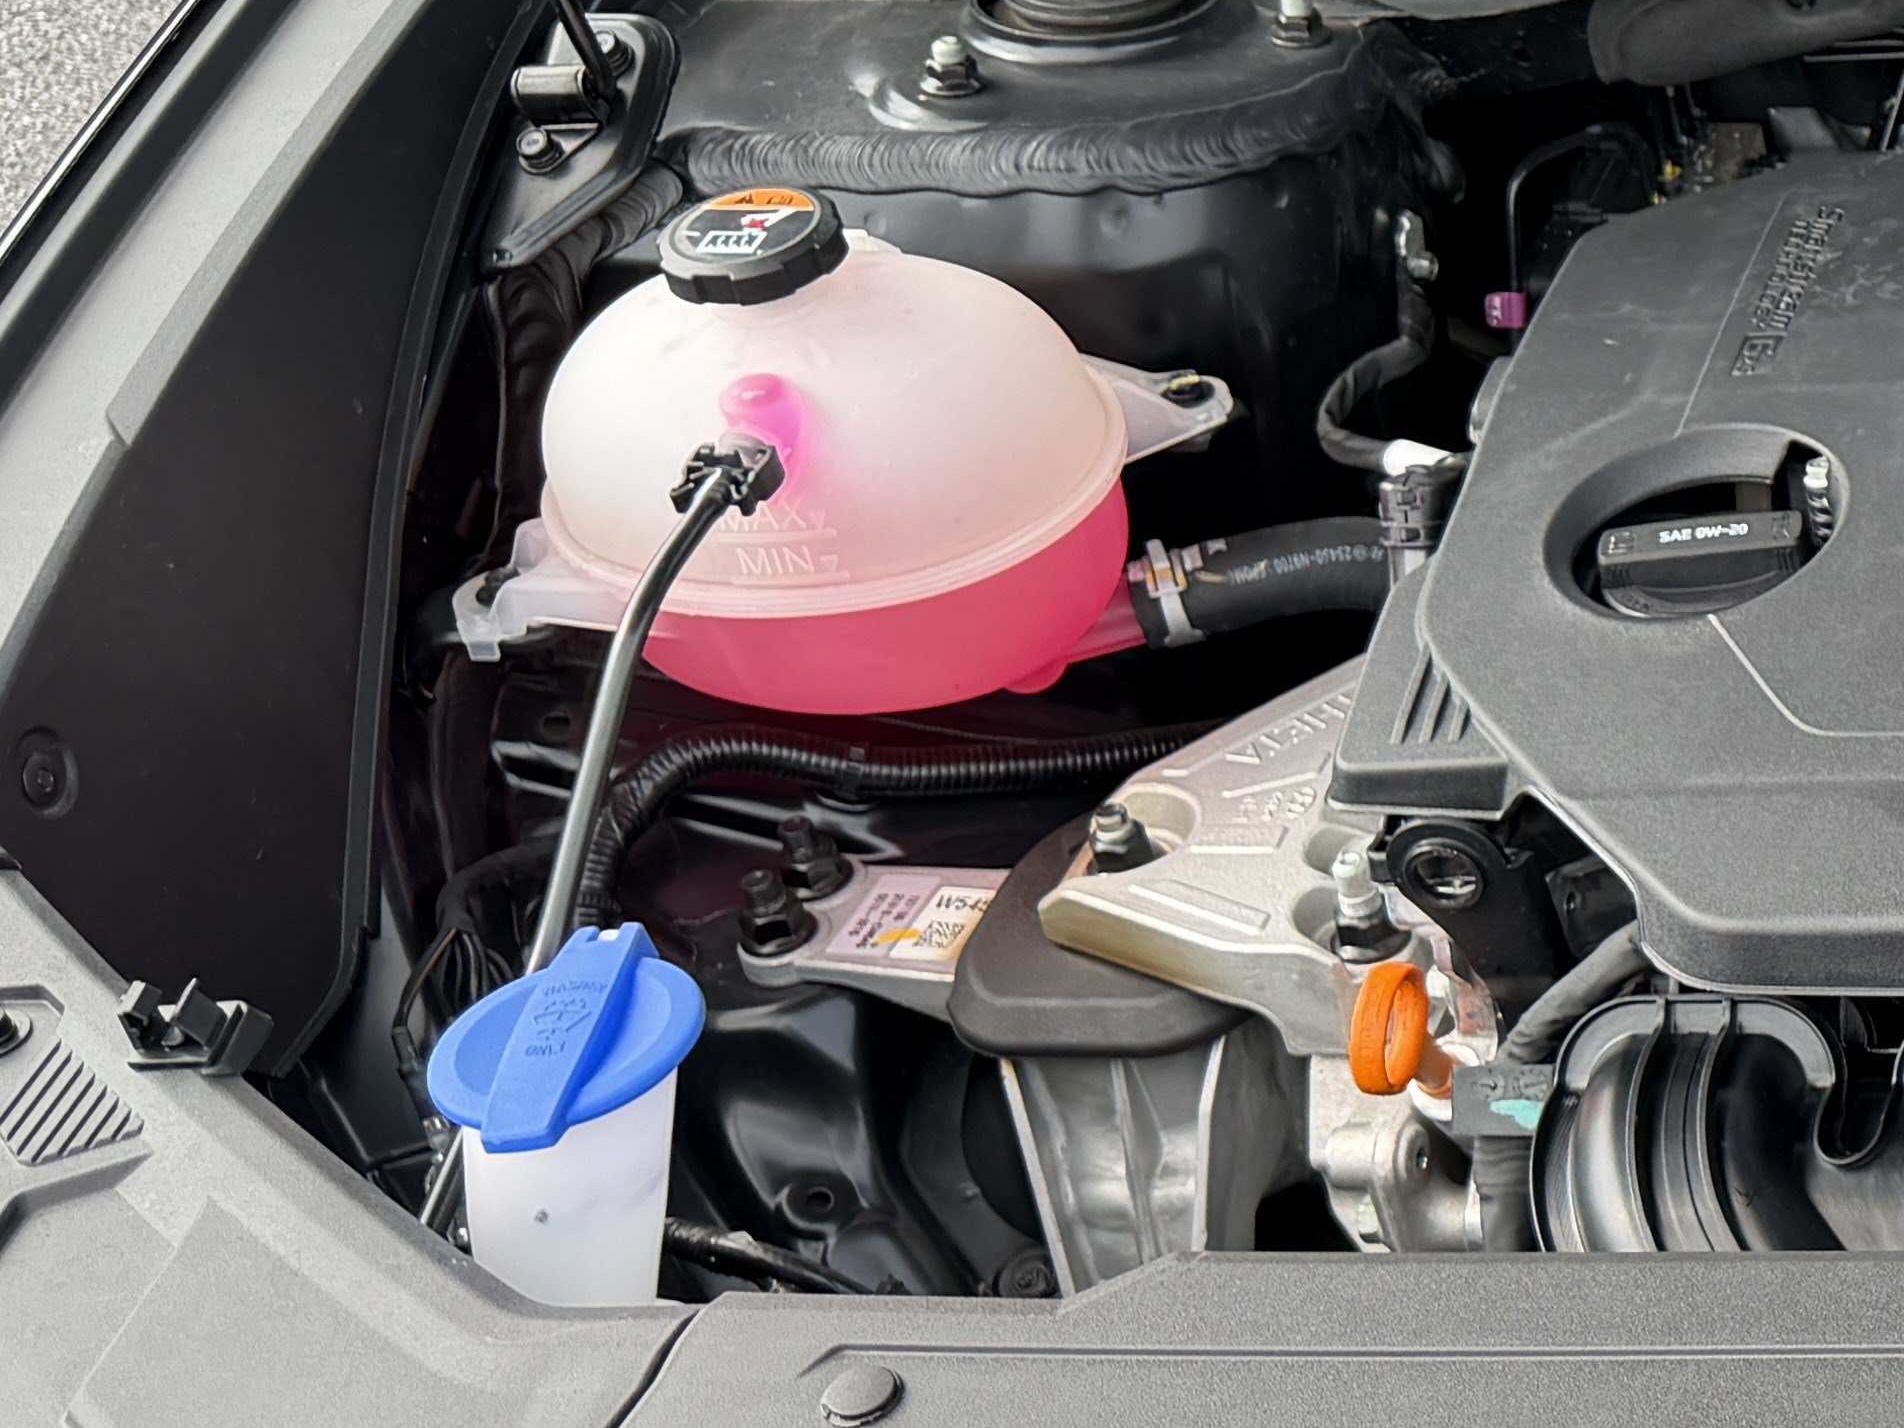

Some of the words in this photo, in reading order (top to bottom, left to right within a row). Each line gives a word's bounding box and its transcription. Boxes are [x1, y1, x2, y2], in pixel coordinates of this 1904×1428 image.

[720, 498, 806, 531] MAX
[1659, 529, 1692, 544] SAE
[1695, 523, 1749, 539] 0W-20
[736, 545, 815, 576] MIN
